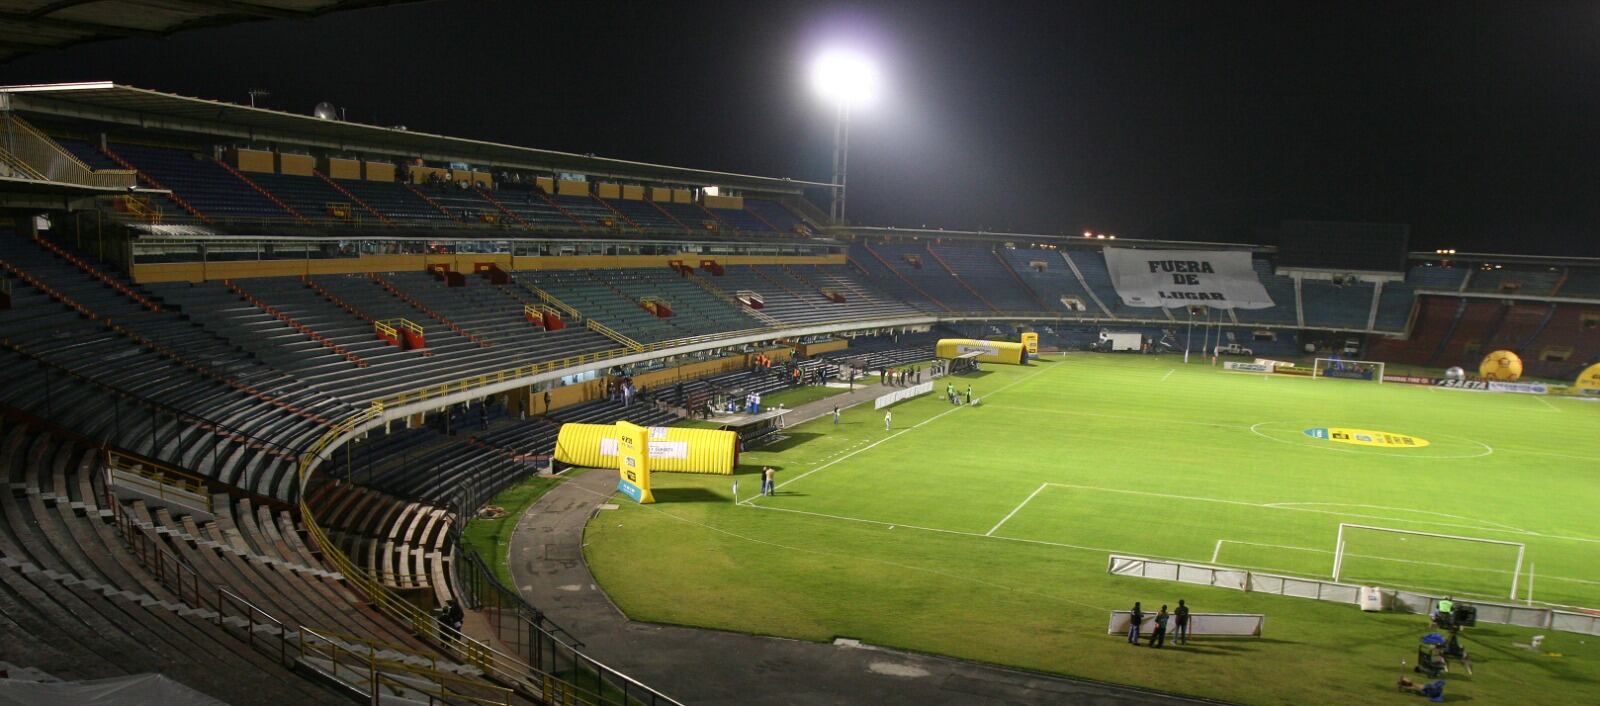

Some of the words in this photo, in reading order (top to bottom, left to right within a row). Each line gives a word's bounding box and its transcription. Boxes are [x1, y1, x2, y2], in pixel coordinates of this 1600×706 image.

[1147, 260, 1215, 273] FUERA
[1172, 273, 1200, 285] DE
[1158, 291, 1227, 301] LUGAR
[1446, 379, 1487, 389] SAETA
